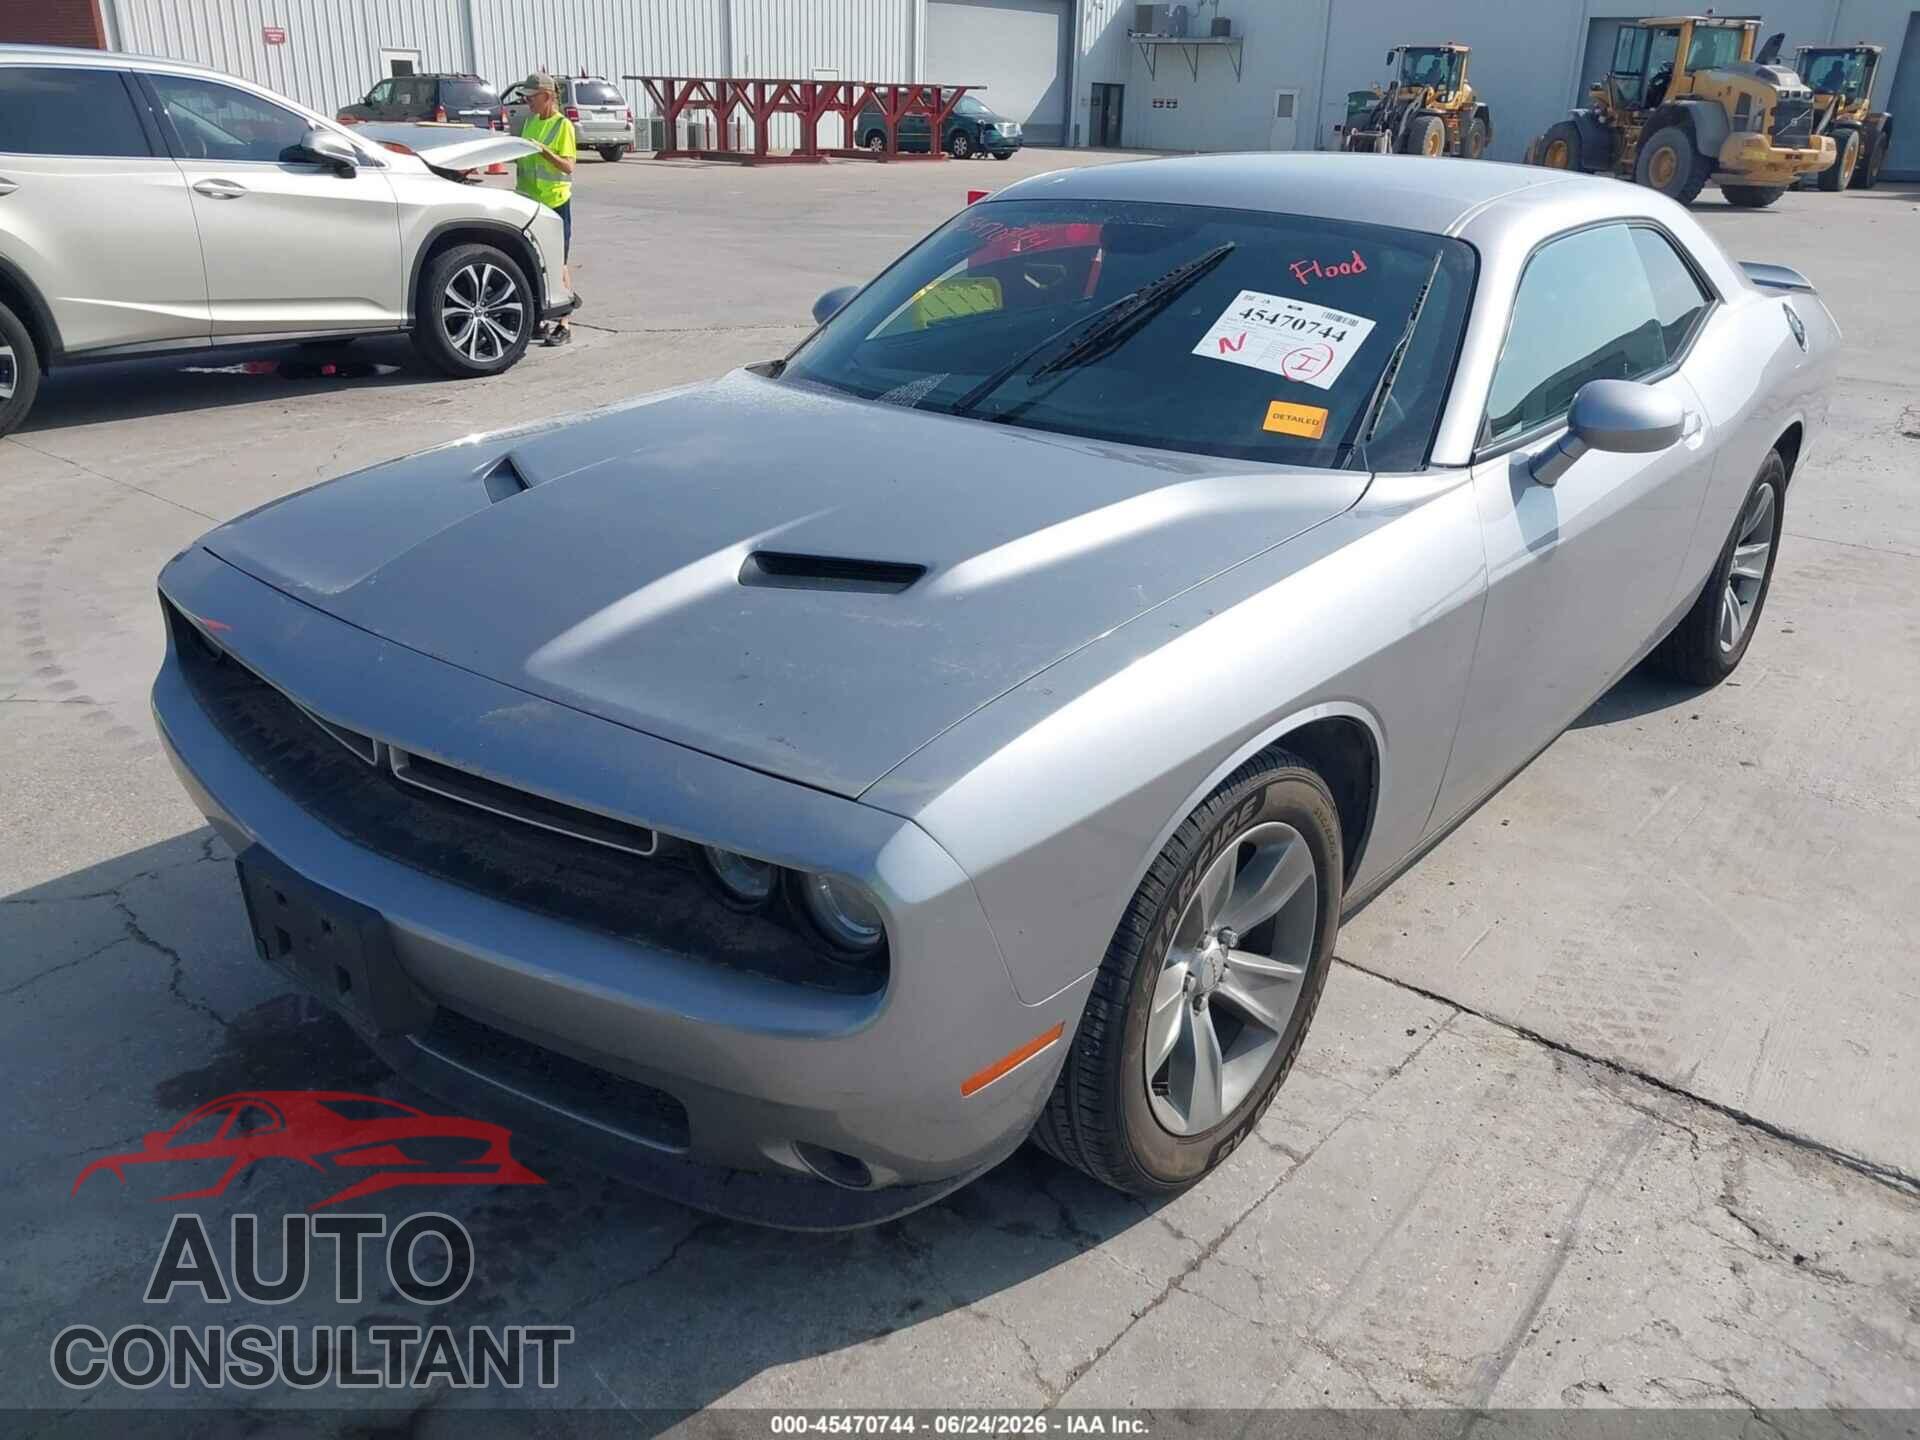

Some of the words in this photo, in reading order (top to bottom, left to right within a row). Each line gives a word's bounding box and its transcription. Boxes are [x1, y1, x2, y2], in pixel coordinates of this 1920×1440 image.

[1289, 250, 1367, 285] Flood
[1238, 307, 1348, 343] 45470744
[1218, 331, 1248, 355] N
[1272, 411, 1320, 427] DETAILED
